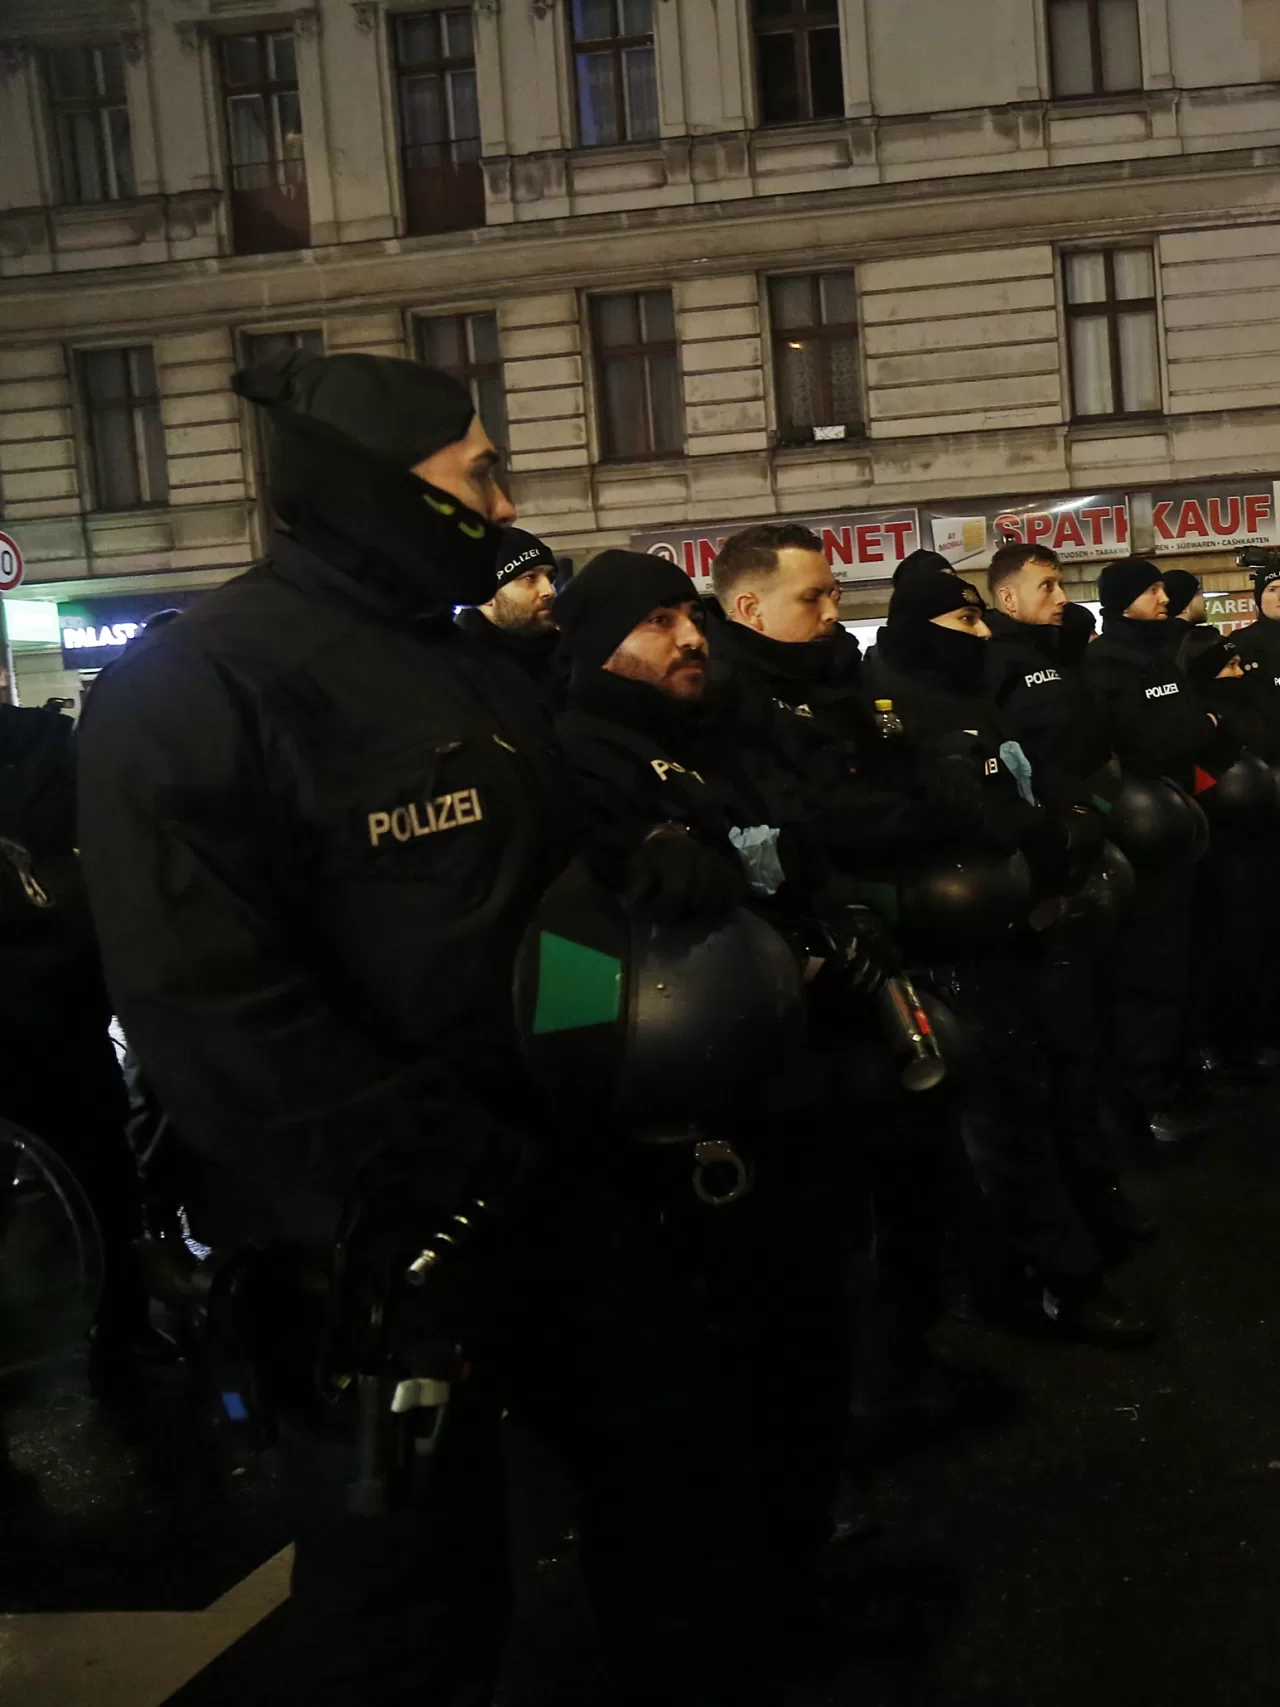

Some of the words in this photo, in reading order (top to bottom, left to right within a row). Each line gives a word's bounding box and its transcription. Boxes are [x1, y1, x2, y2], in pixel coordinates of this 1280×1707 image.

[1221, 537, 1270, 546] CASHKARTEN
[496, 548, 541, 580] POLIZEI
[63, 622, 139, 649] PALAST
[1145, 682, 1180, 699] POLIZEI
[367, 787, 484, 847] POLIZEI
